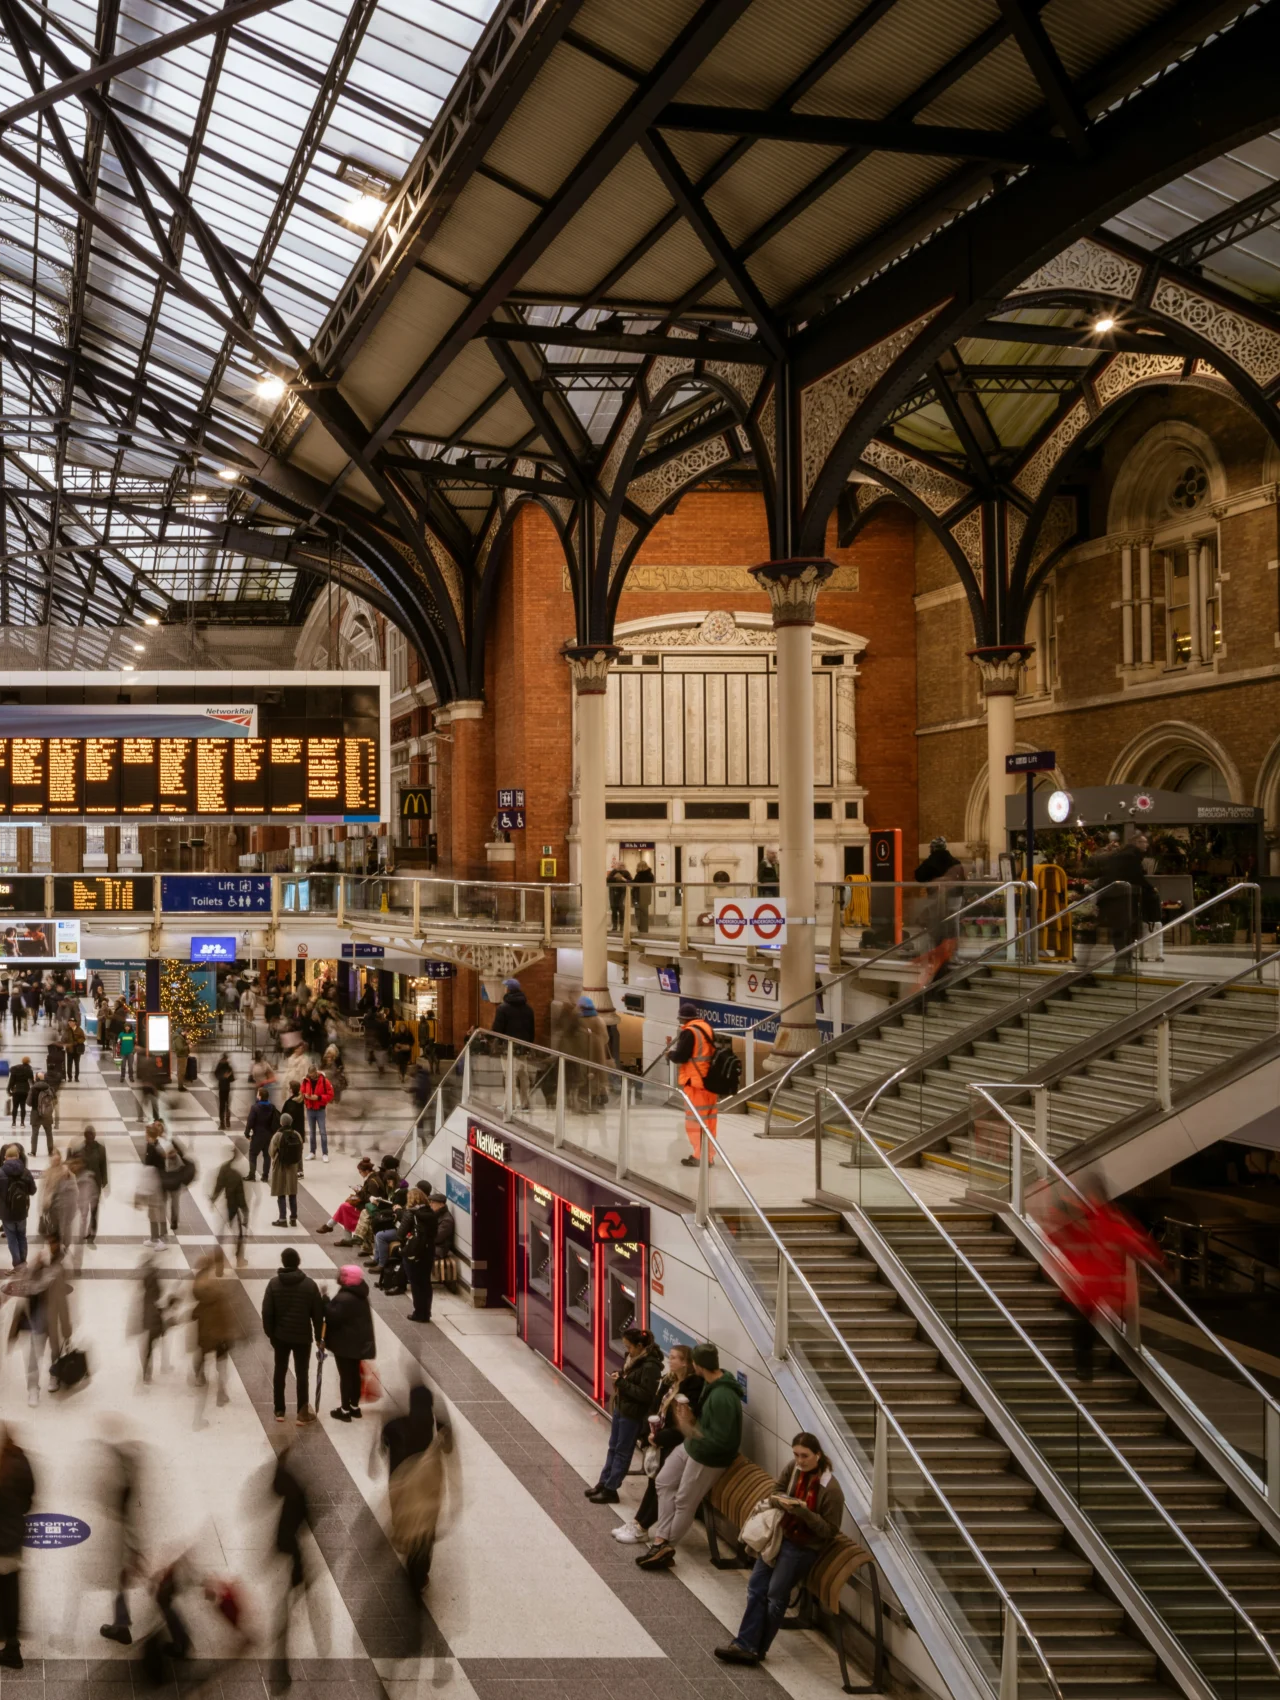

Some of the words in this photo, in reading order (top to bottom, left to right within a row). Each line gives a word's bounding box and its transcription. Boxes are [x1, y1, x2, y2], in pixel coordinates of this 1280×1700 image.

[1028, 756, 1038, 764] Lift
[218, 881, 235, 891] Lift
[191, 896, 223, 906] Toilets
[695, 1008, 721, 1023] ERPOOL
[723, 1012, 748, 1028] STREET
[476, 1128, 505, 1163] NatWest
[533, 1183, 552, 1201] NatWest
[571, 1205, 592, 1225] NatWest
